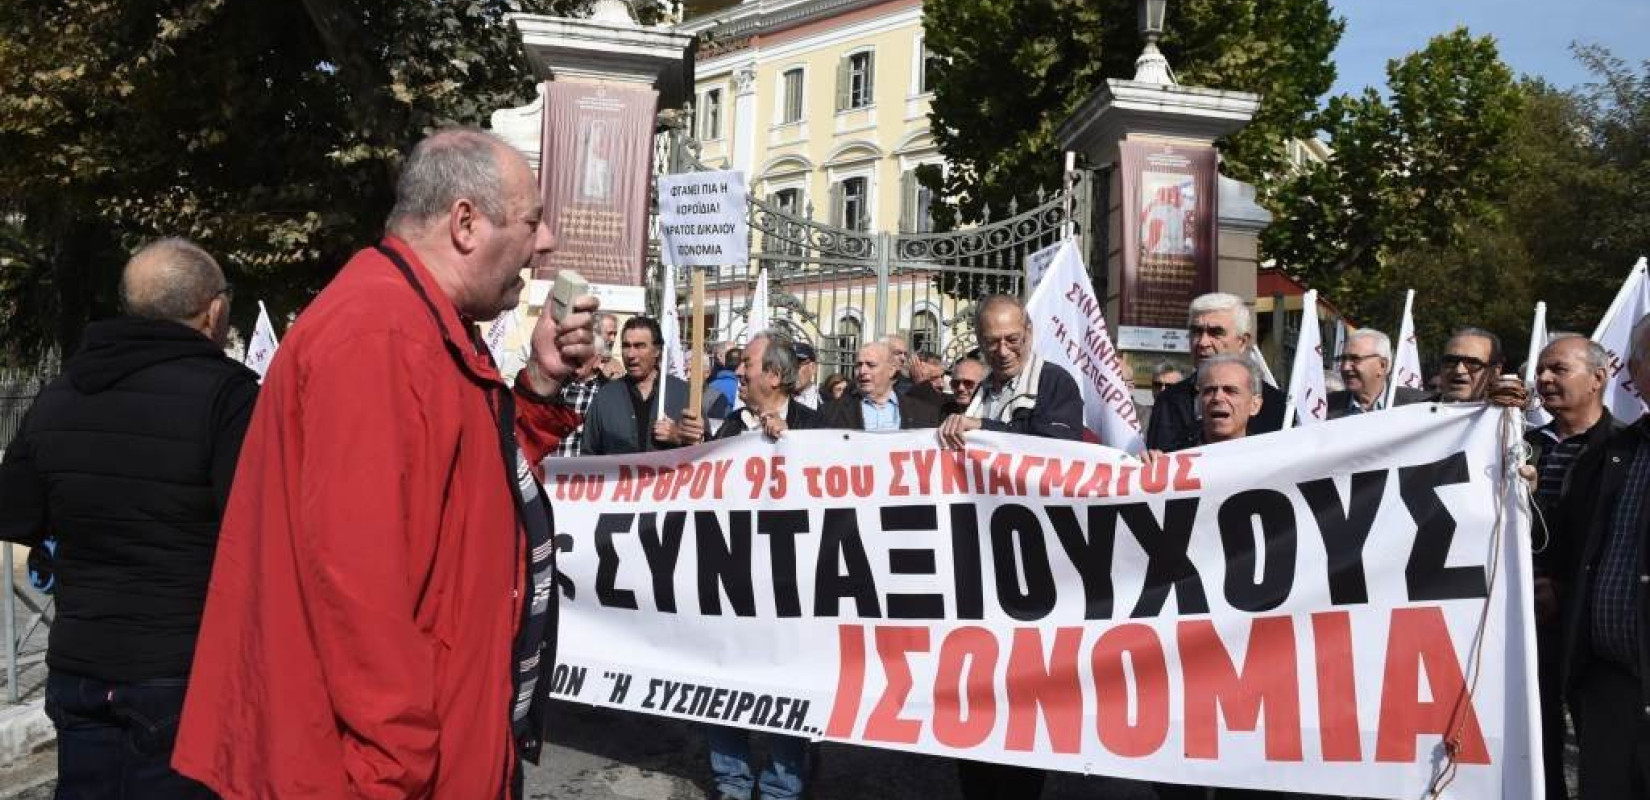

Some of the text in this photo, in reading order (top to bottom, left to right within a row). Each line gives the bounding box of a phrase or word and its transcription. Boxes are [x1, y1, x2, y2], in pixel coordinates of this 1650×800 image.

[702, 183, 718, 194] ΠΙΑ
[697, 223, 735, 235] ΔΙΚΑΙΟΥ
[555, 474, 605, 502] του
[612, 459, 734, 503] ΑΡΘΡΟΥ
[745, 457, 787, 500] 95
[803, 465, 874, 498] του
[888, 449, 1202, 498] ΣΥΝΤΑΓΜΑΤΟΣ
[594, 451, 1488, 621] ΣΥΝΤΑΞΙΟΥΧΟΥΣ
[825, 606, 1492, 766] ΙΣΟΝΟΜΙΑ
